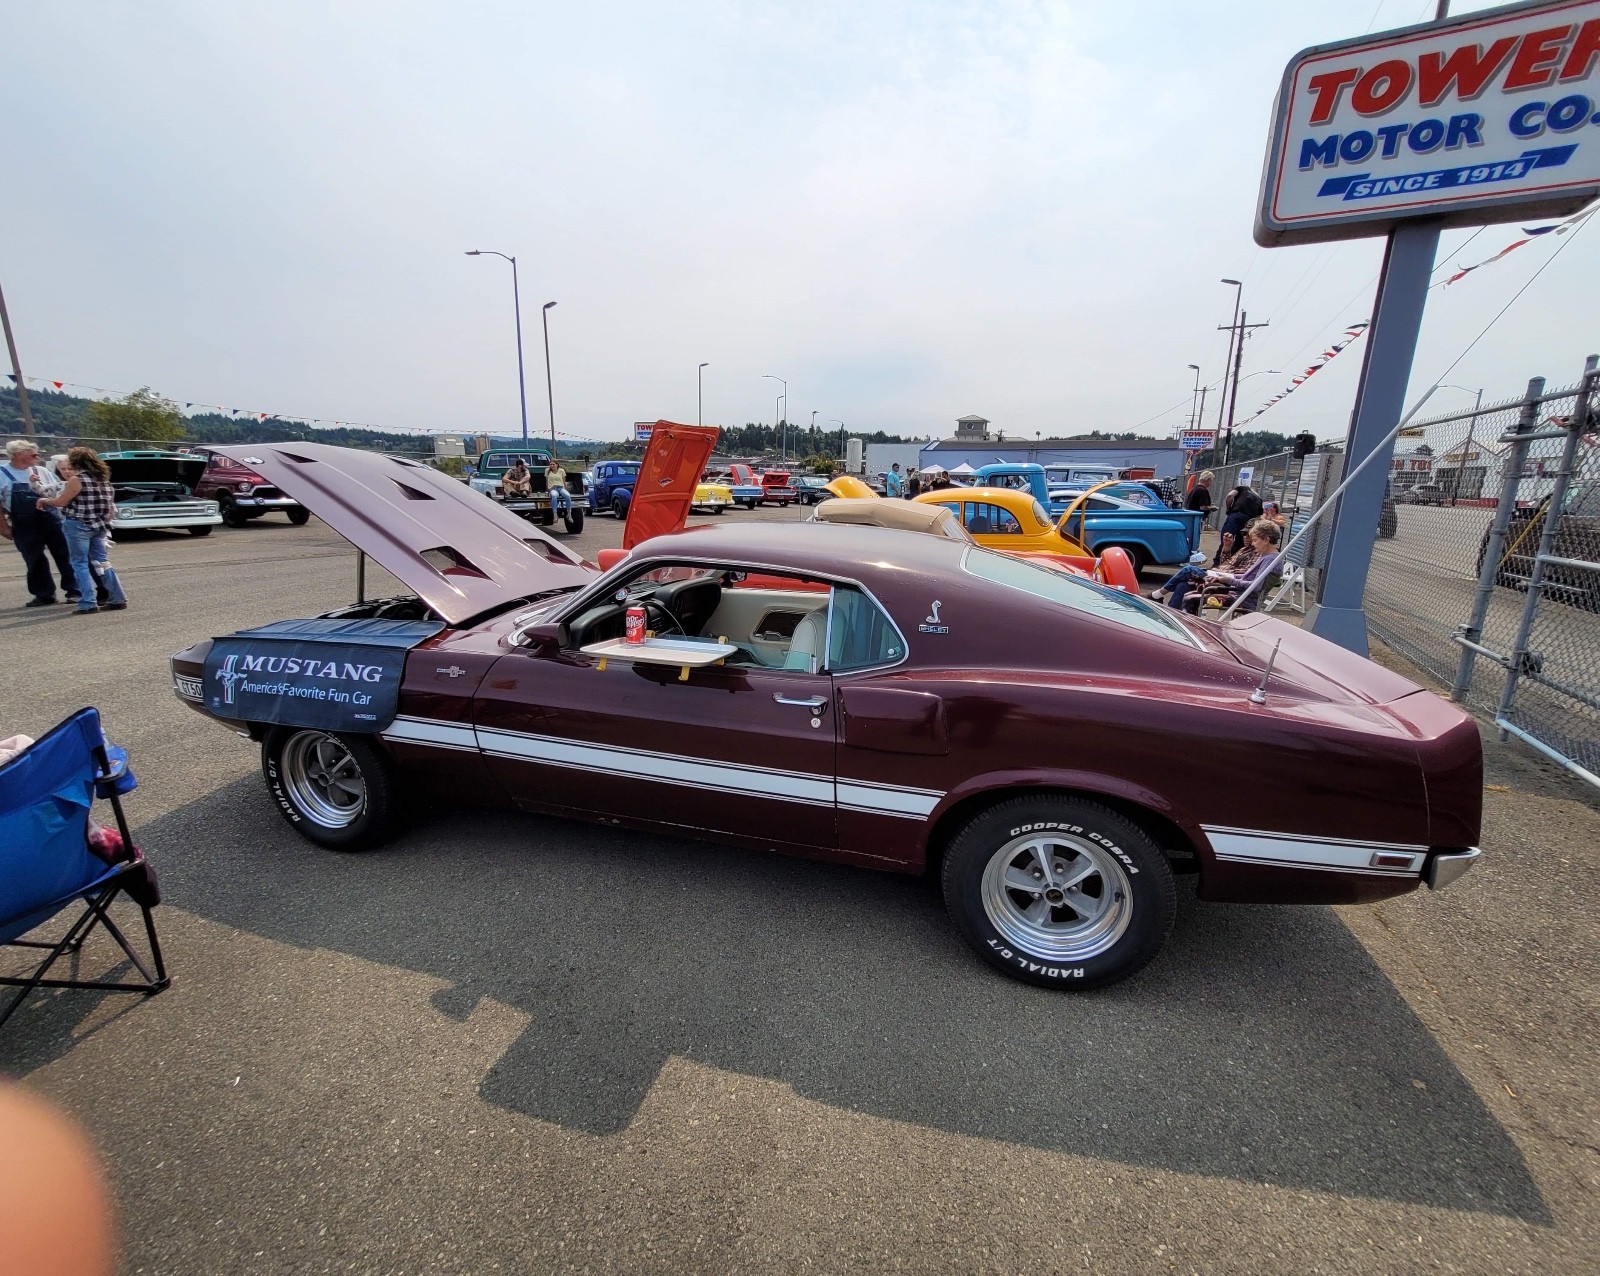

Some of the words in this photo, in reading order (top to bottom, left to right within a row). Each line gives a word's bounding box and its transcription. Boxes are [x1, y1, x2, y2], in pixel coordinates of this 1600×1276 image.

[1298, 112, 1484, 171] MOTOR
[1508, 94, 1600, 140] CO.
[1353, 172, 1444, 198] SINCE
[1457, 161, 1526, 185] 1914
[240, 654, 383, 683] MUSTANG
[181, 681, 203, 697] GT50
[281, 683, 326, 700] Favorite
[328, 688, 350, 703] Fun
[352, 691, 373, 705] Car
[268, 757, 277, 778] G/T
[273, 781, 301, 822] RADIAL
[1010, 822, 1084, 836] COOPER
[1088, 832, 1140, 875] COBRA
[986, 938, 1014, 959] G/T
[1018, 957, 1085, 978] RADIAL
